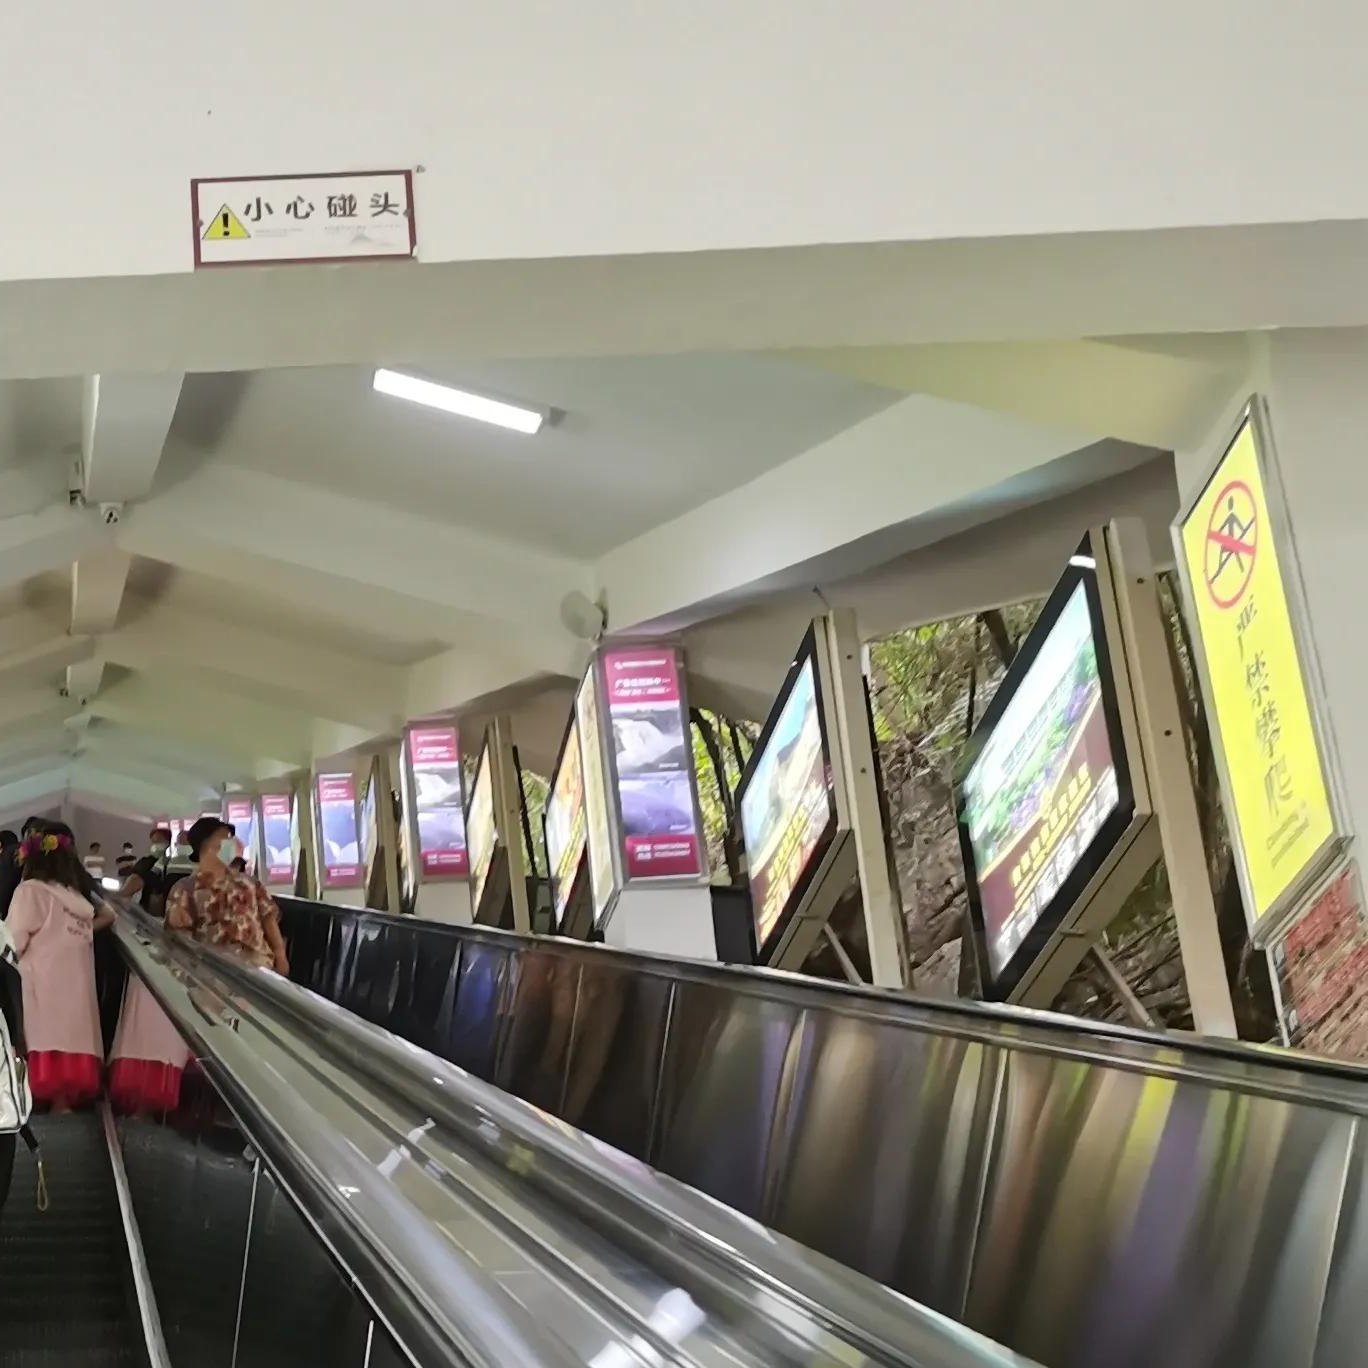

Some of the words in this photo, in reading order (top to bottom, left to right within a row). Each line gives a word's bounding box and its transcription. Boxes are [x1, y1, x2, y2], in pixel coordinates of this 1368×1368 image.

[243, 191, 400, 222] 小心碰头
[1236, 594, 1293, 817] 严禁攀爬
